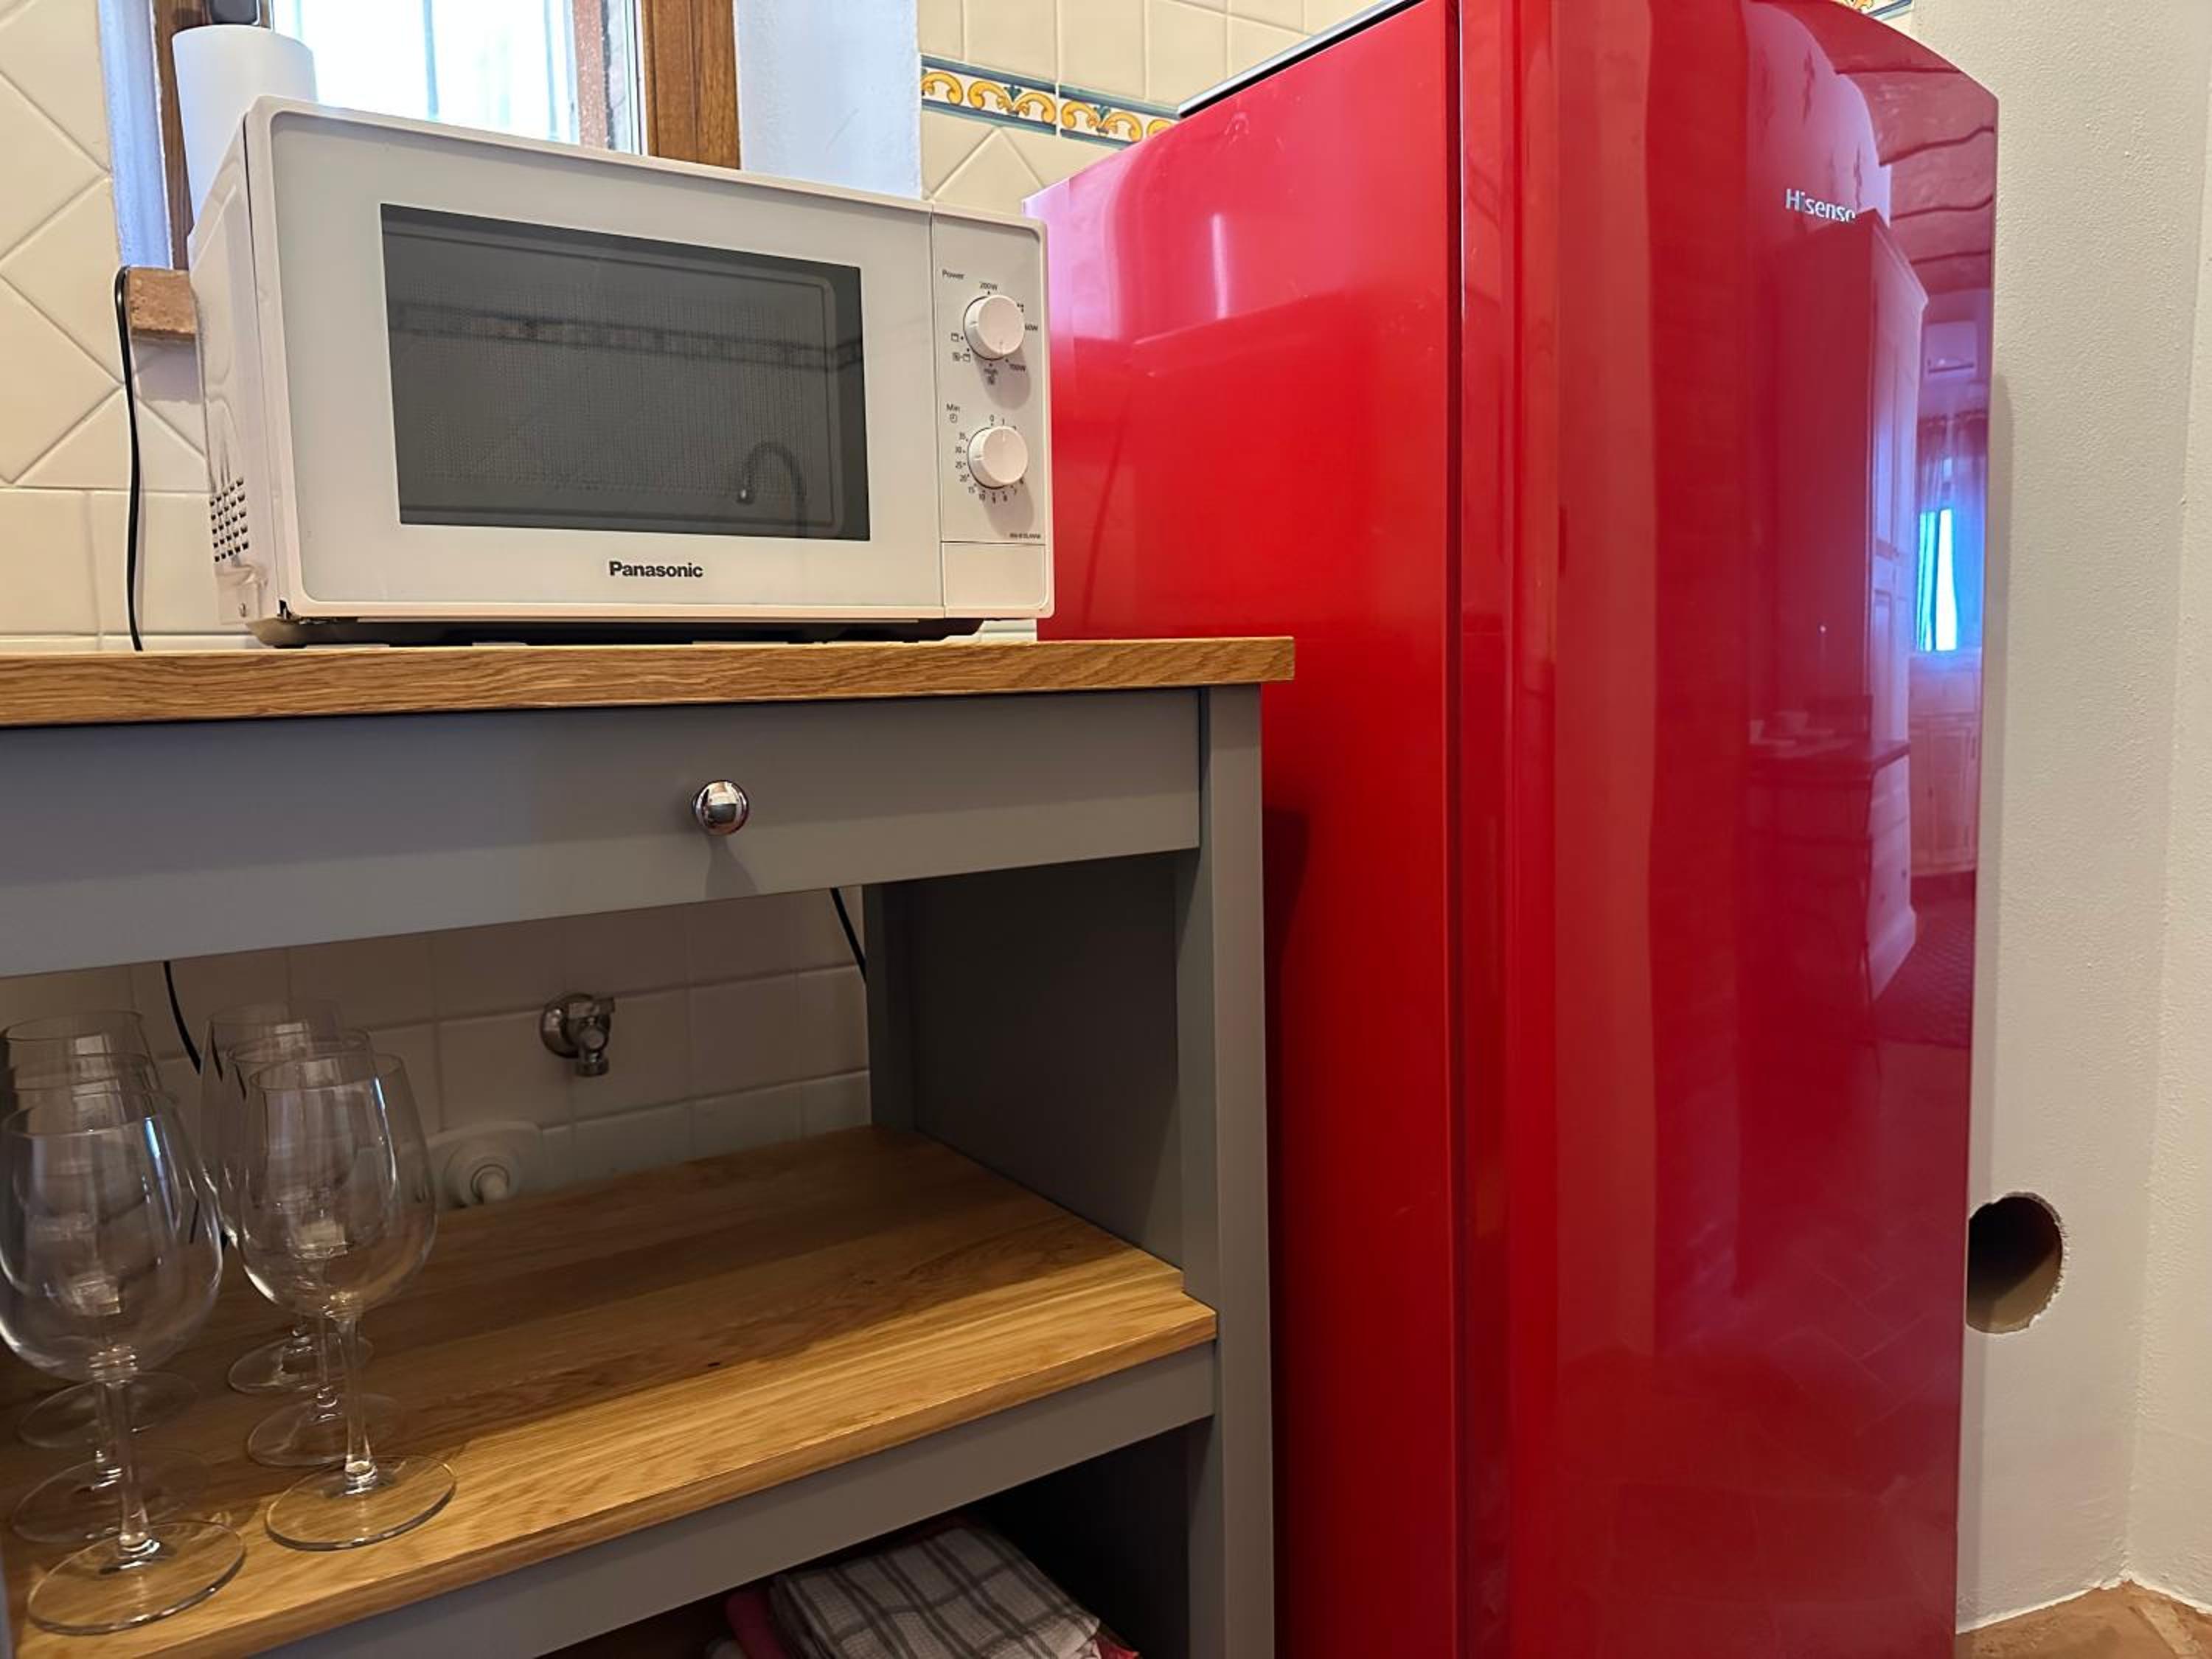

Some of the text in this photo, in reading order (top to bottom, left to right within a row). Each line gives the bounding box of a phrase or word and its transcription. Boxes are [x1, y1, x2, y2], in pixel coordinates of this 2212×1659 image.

[942, 268, 964, 279] Power
[946, 403, 961, 412] Min
[609, 560, 703, 578] Panasonic
